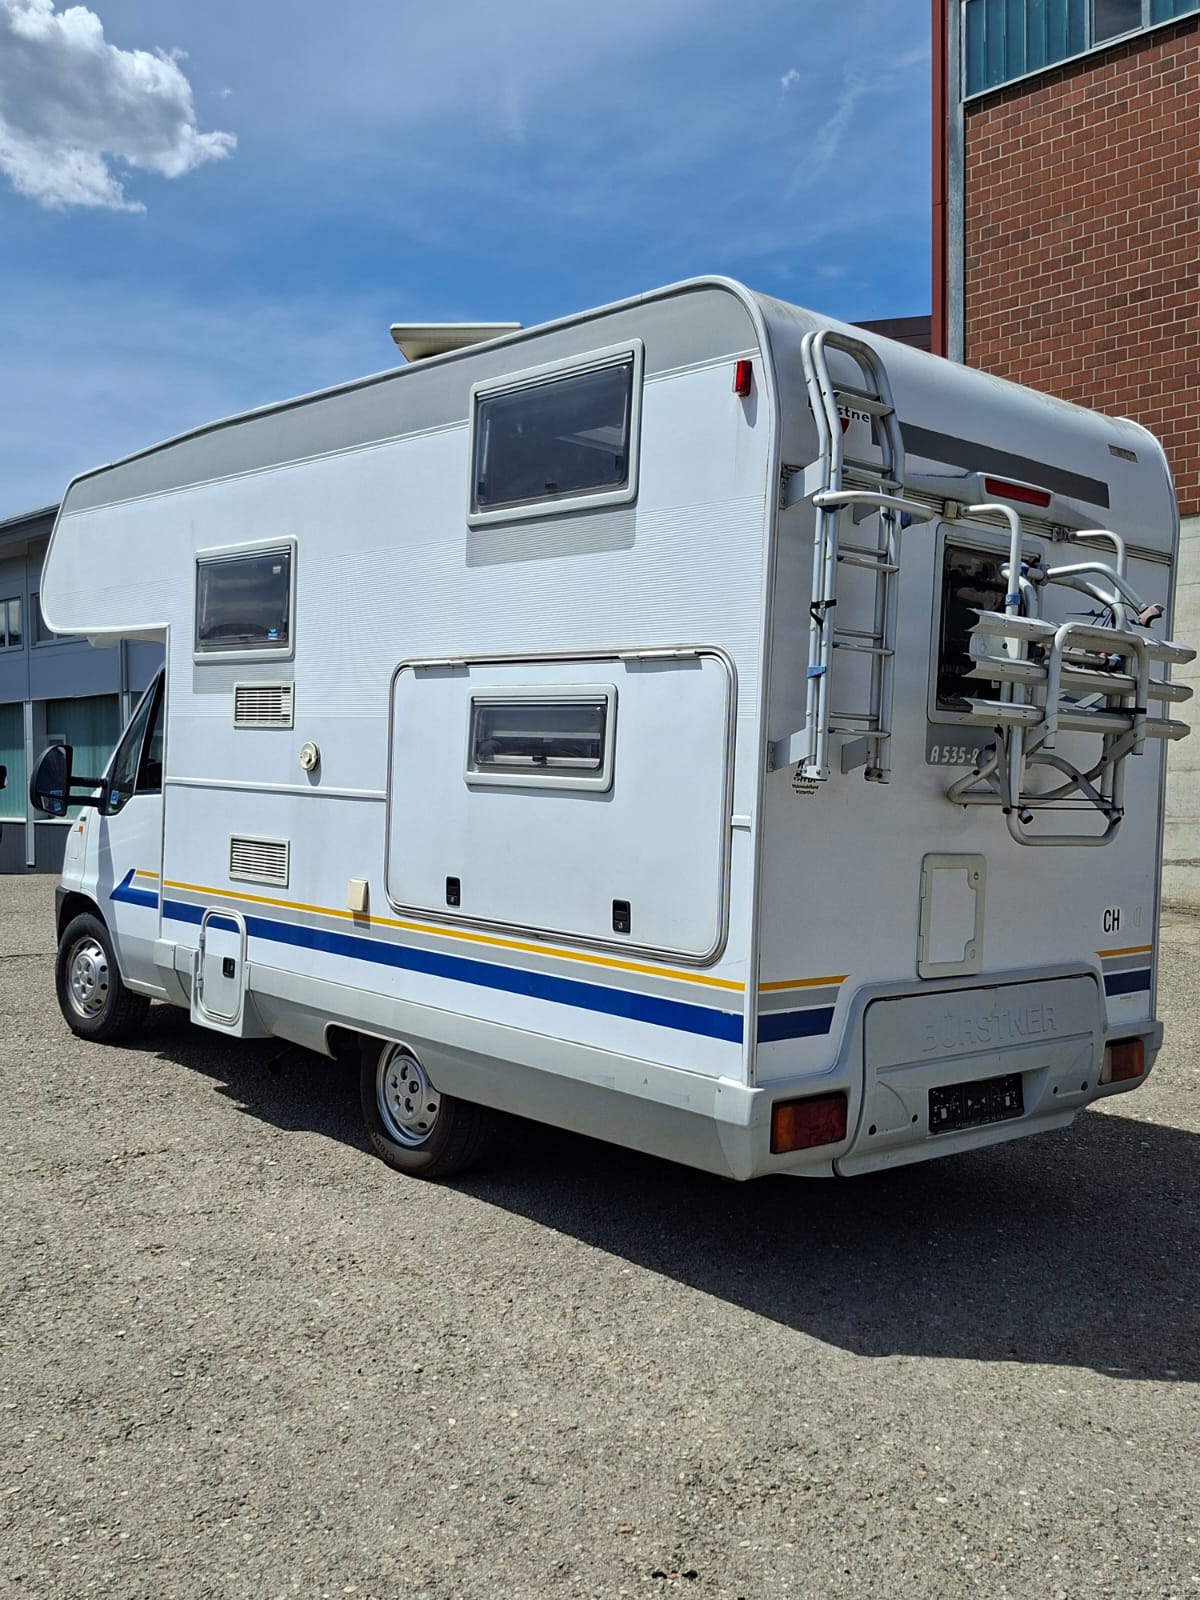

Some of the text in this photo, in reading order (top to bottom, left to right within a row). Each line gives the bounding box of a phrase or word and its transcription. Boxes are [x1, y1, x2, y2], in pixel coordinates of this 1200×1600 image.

[930, 745, 940, 763] A
[1103, 908, 1120, 933] CH
[920, 1004, 1058, 1053] BÜRSTNER
